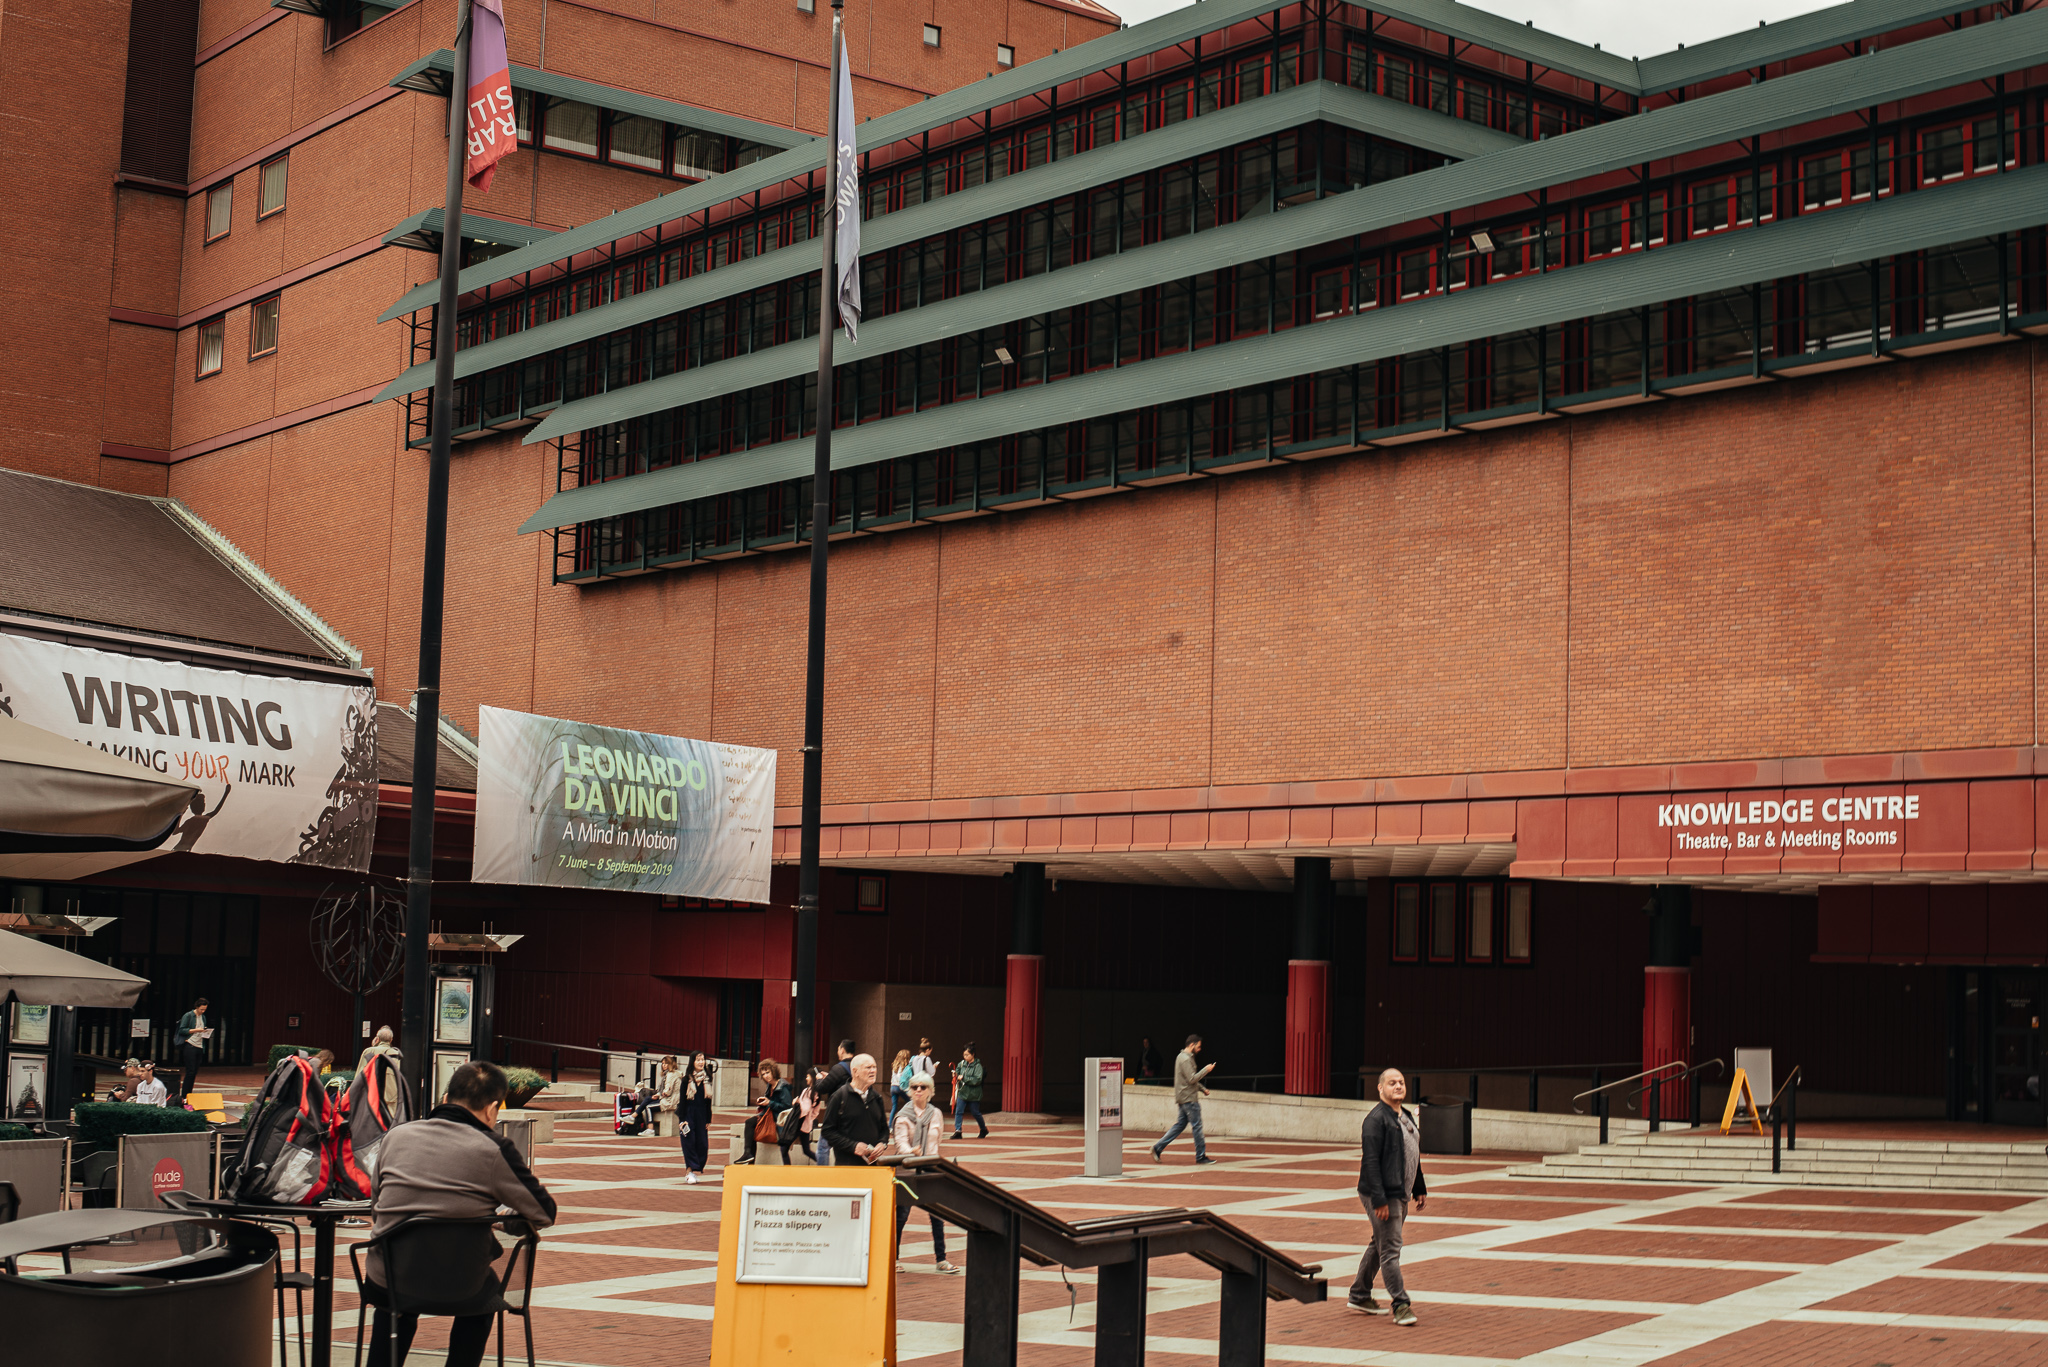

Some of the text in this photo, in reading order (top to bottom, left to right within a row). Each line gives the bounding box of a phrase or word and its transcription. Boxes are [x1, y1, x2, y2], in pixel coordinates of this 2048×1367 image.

[468, 112, 516, 160] RAR
[62, 671, 293, 751] WRITING
[74, 738, 296, 788] KING YOUR MARK
[561, 741, 707, 791] LEONARDO
[564, 777, 678, 822] DA VINCI
[1658, 795, 1920, 827] KNOWLEDGE CENTRE
[562, 821, 678, 851] A Mind in Motion
[1676, 828, 1898, 851] Theatre, Bar & Meeting Rooms
[558, 855, 566, 867] 7
[565, 855, 588, 869] June
[597, 857, 604, 870] 8
[605, 858, 650, 875] September
[650, 863, 673, 876] 2019
[154, 1170, 181, 1182] nude
[753, 1220, 822, 1231] Piazza slippery
[755, 1207, 831, 1218] Please take care,
